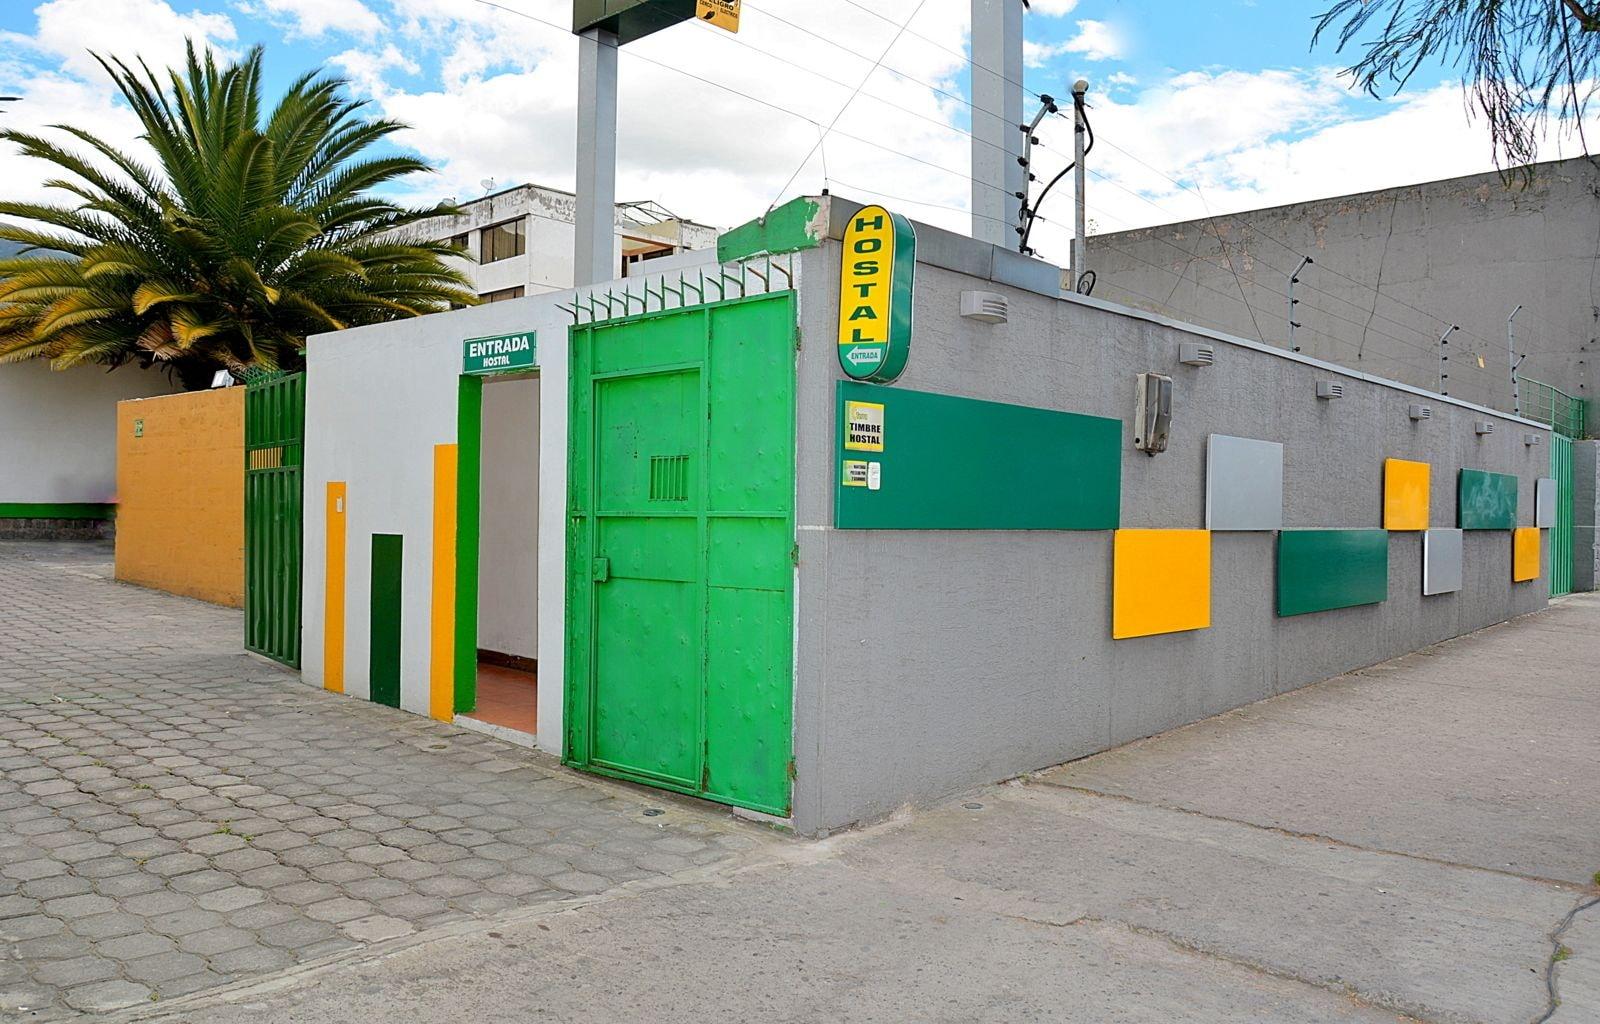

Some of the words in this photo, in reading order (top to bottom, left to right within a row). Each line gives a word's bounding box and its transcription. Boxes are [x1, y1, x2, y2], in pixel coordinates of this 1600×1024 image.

[849, 215, 883, 343] HOSTAL
[469, 336, 530, 358] ENTRADA
[483, 355, 510, 368] HOSTAL
[851, 351, 878, 360] ENTRADA
[849, 422, 881, 433] TIMBRE
[849, 434, 881, 445] HOSTAL
